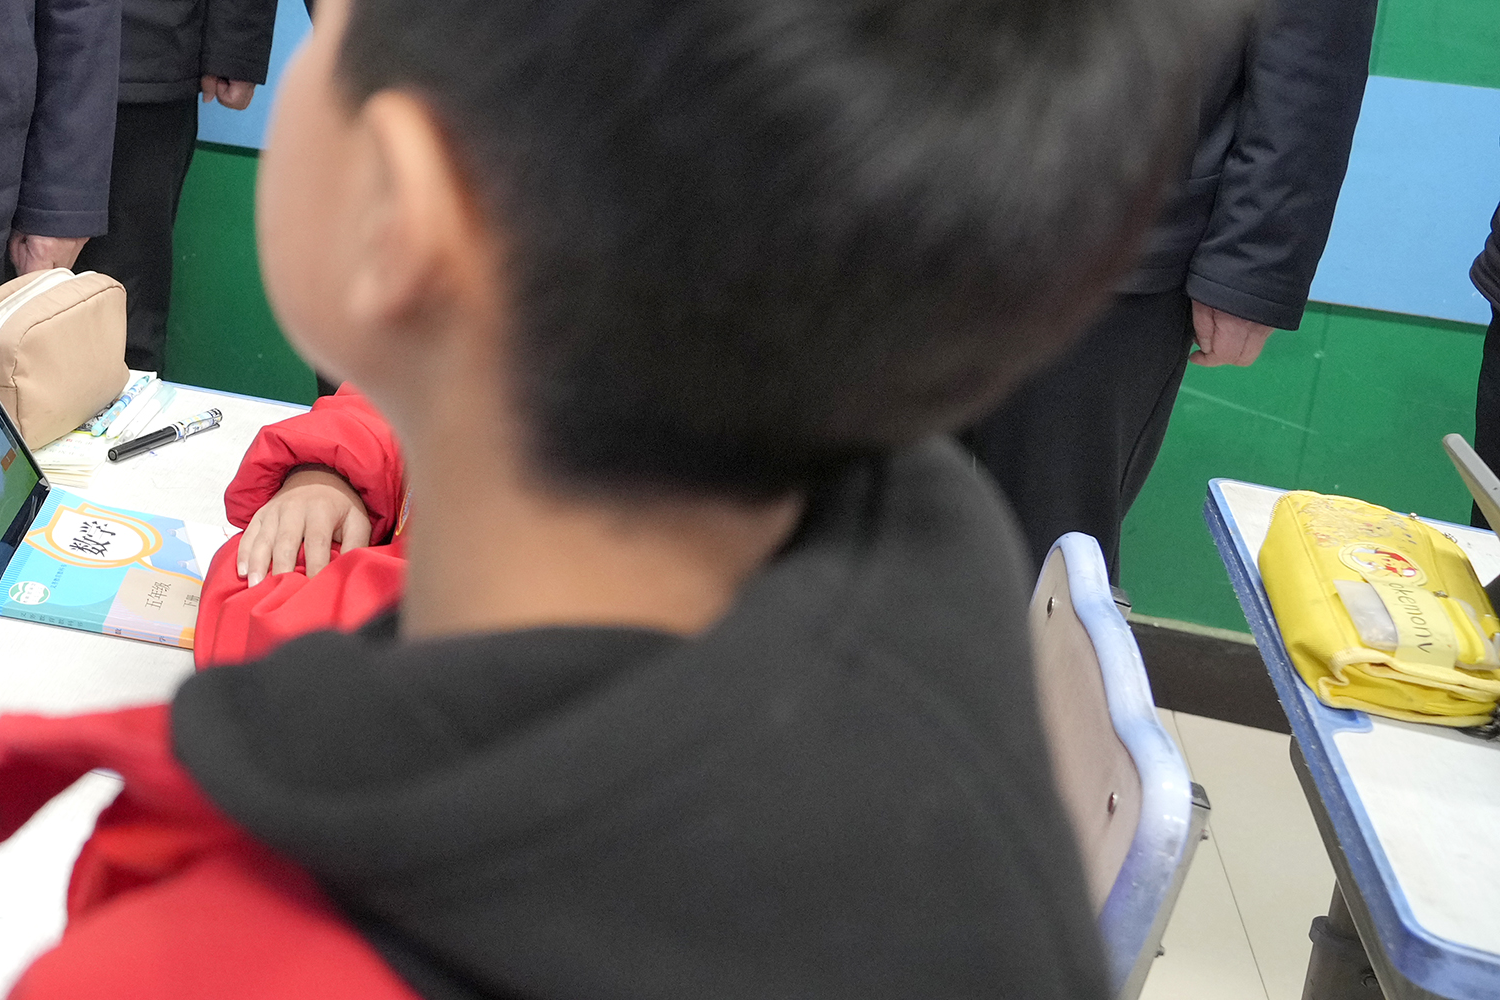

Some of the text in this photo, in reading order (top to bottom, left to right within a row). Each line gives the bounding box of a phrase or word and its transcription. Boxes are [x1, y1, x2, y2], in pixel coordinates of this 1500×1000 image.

[69, 520, 117, 558] 数学
[145, 581, 172, 611] 五年级
